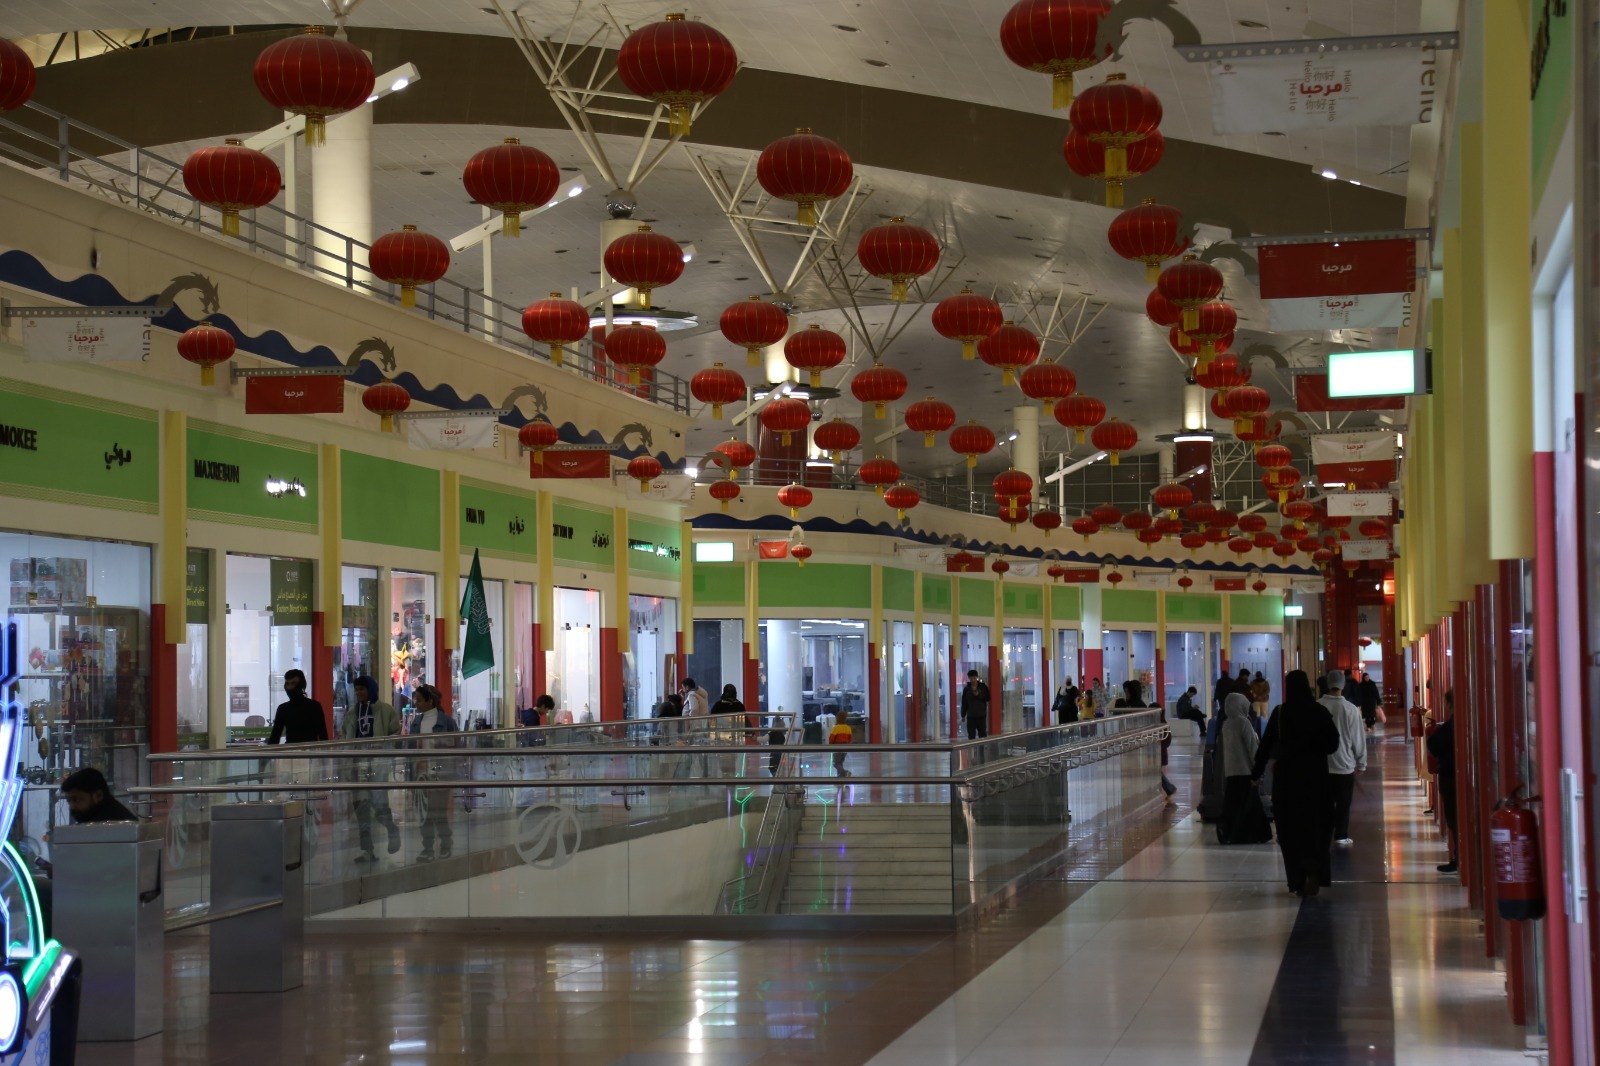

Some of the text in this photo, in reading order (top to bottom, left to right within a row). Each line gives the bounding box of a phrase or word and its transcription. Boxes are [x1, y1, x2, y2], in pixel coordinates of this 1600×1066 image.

[1304, 60, 1312, 83] Hello
[1344, 69, 1352, 93] Hello
[1300, 82, 1342, 98] مرحبا
[1322, 263, 1352, 275] مرحبا
[1326, 299, 1354, 310] مرحبا
[74, 334, 100, 344] مرحبا
[284, 390, 304, 399] مرحبا
[444, 429, 462, 437] مرحبا
